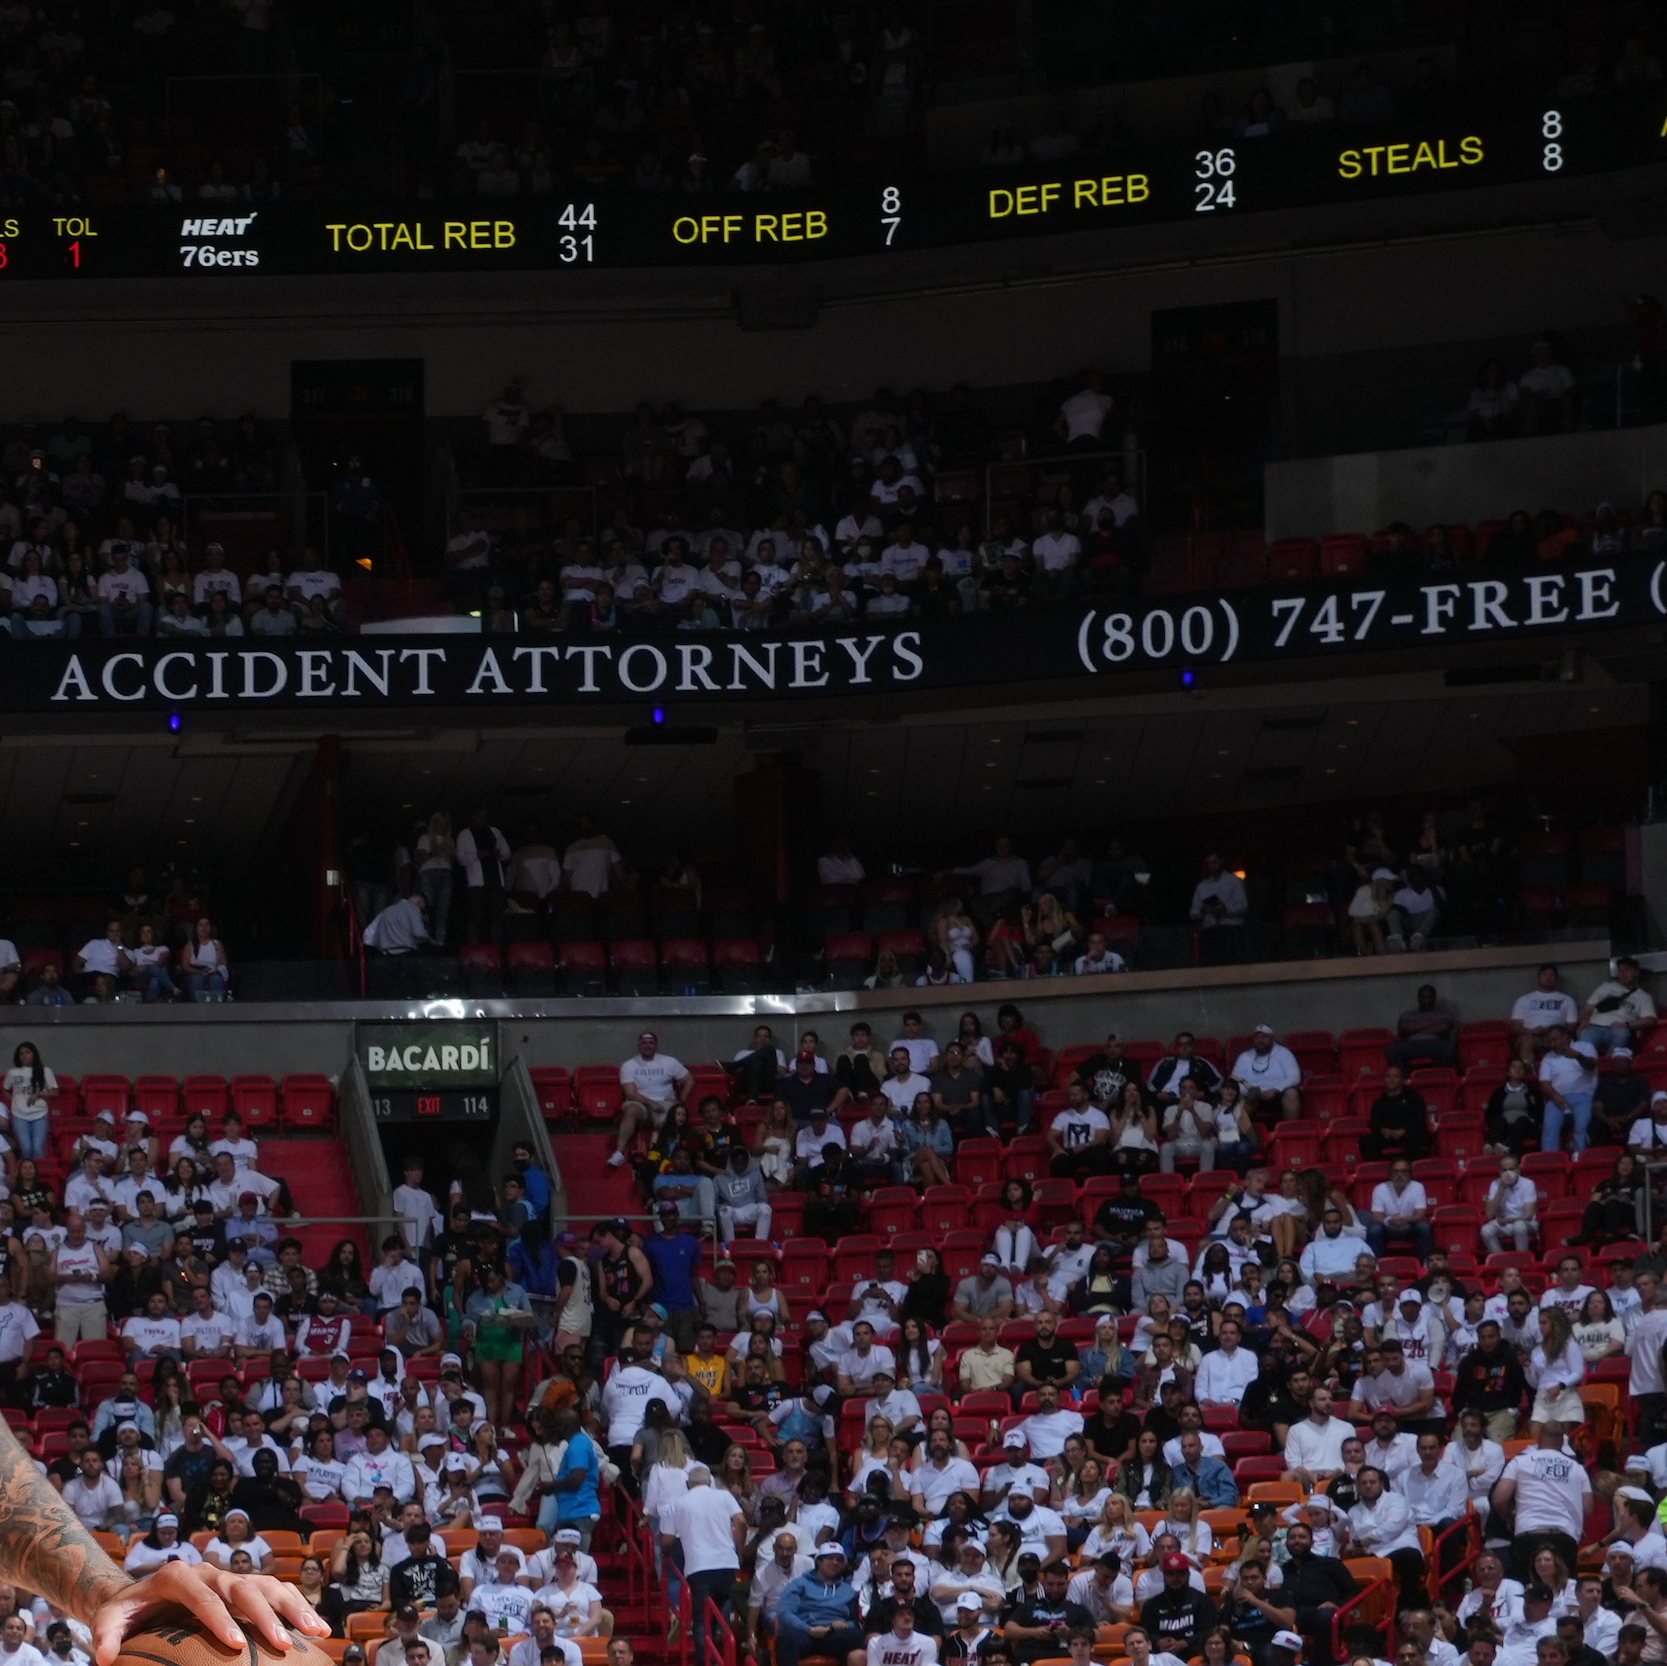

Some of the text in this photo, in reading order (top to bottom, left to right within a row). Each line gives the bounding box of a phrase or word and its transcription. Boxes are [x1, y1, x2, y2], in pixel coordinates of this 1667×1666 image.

[1541, 110, 1563, 139] 8
[1194, 148, 1236, 180] 36
[1338, 136, 1485, 180] STEALS
[1543, 142, 1564, 172] 8
[880, 186, 901, 214] 8
[989, 173, 1150, 218] DEF REB
[1193, 180, 1237, 213] 24
[52, 217, 98, 236] TOL
[181, 212, 258, 236] HEAT
[557, 203, 597, 231] 44
[672, 211, 828, 245] OFF REB
[880, 217, 901, 246] 7
[325, 221, 516, 251] TOTAL REB
[558, 234, 595, 263] 31
[68, 242, 81, 268] 1
[179, 245, 260, 268] 76ers
[50, 646, 447, 702] ACCIDENT
[465, 632, 925, 697] ATTORNEYS
[1077, 598, 1240, 672] (800)
[1272, 567, 1622, 649] 747-FREE
[368, 1038, 491, 1072] BACARDÍ
[372, 1096, 489, 1116] 13 EXIT 114
[1158, 1613, 1195, 1631] MIAMI
[882, 1648, 922, 1665] HEAT
